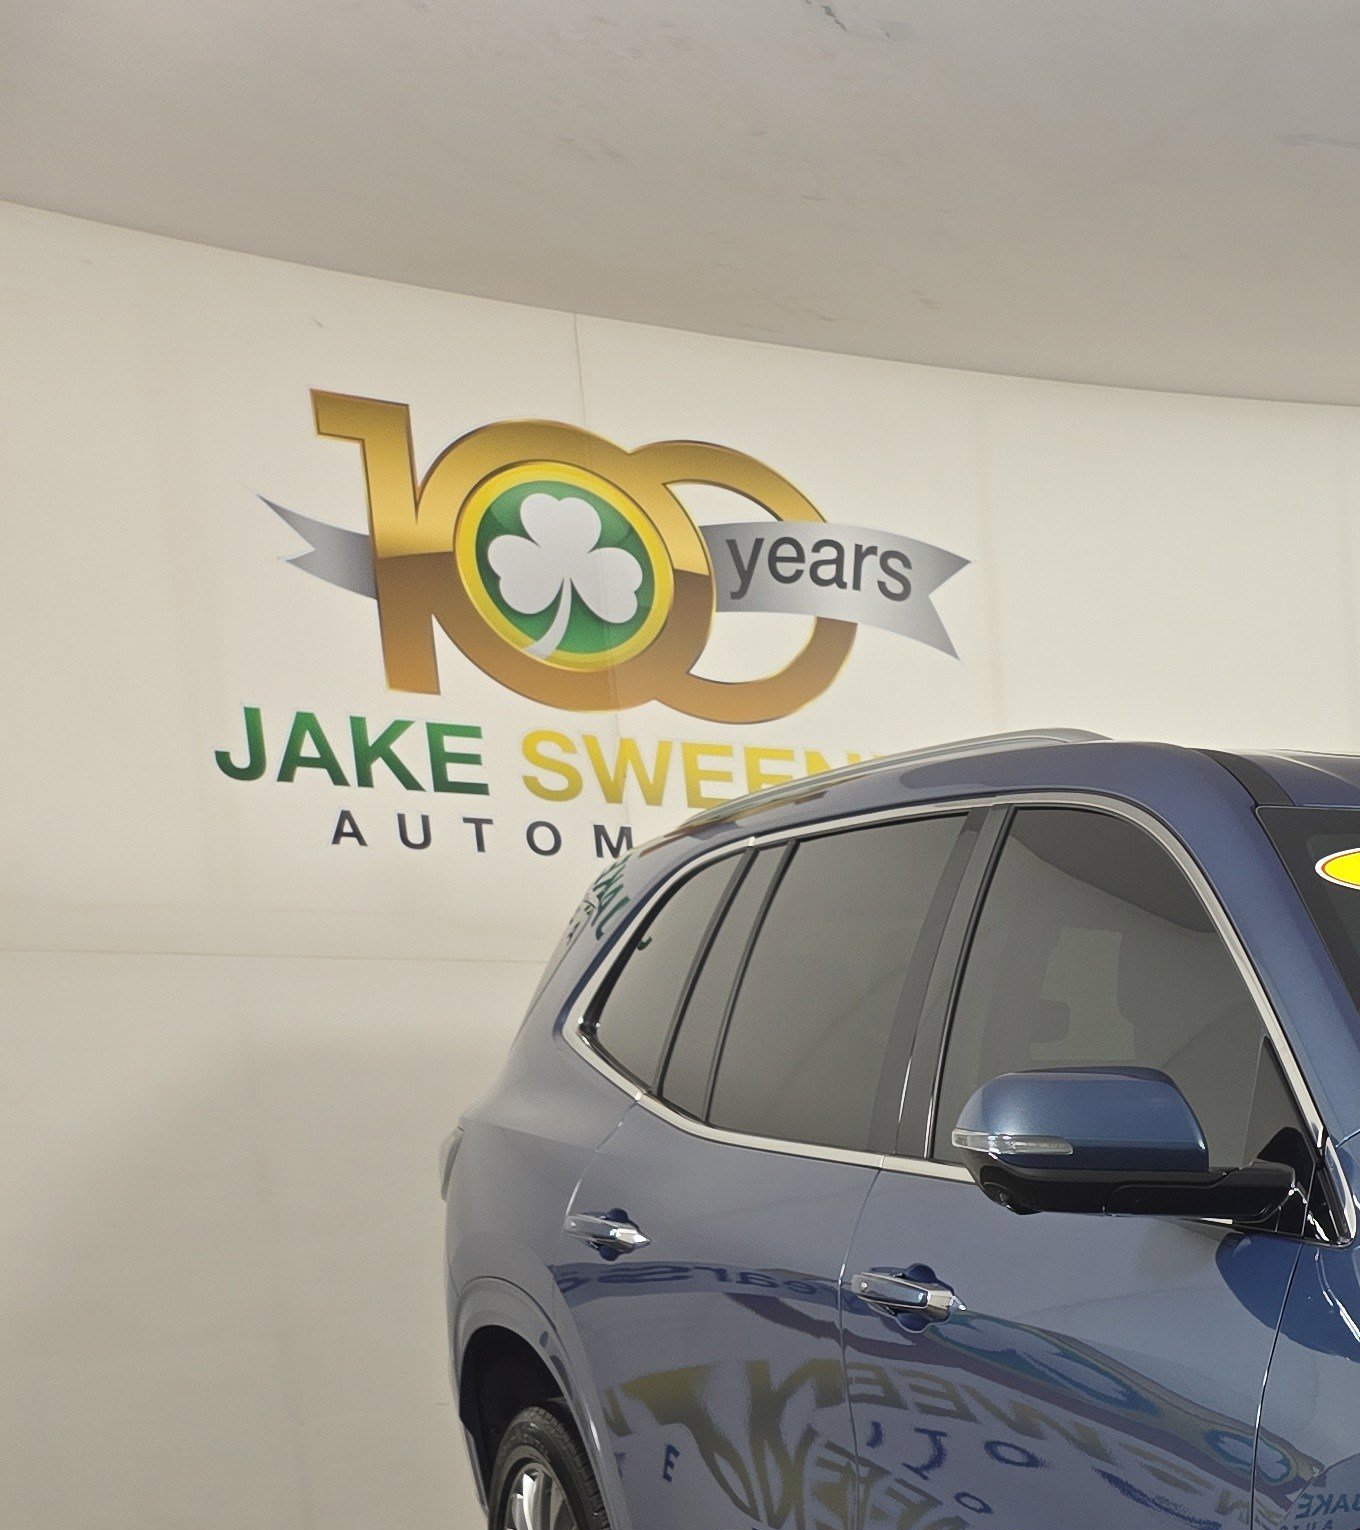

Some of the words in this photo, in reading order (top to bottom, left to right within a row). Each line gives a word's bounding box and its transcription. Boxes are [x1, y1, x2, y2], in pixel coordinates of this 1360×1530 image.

[725, 534, 913, 602] years
[214, 706, 491, 796] JAKE
[521, 729, 886, 809] SWEE
[331, 809, 634, 859] AUTOM
